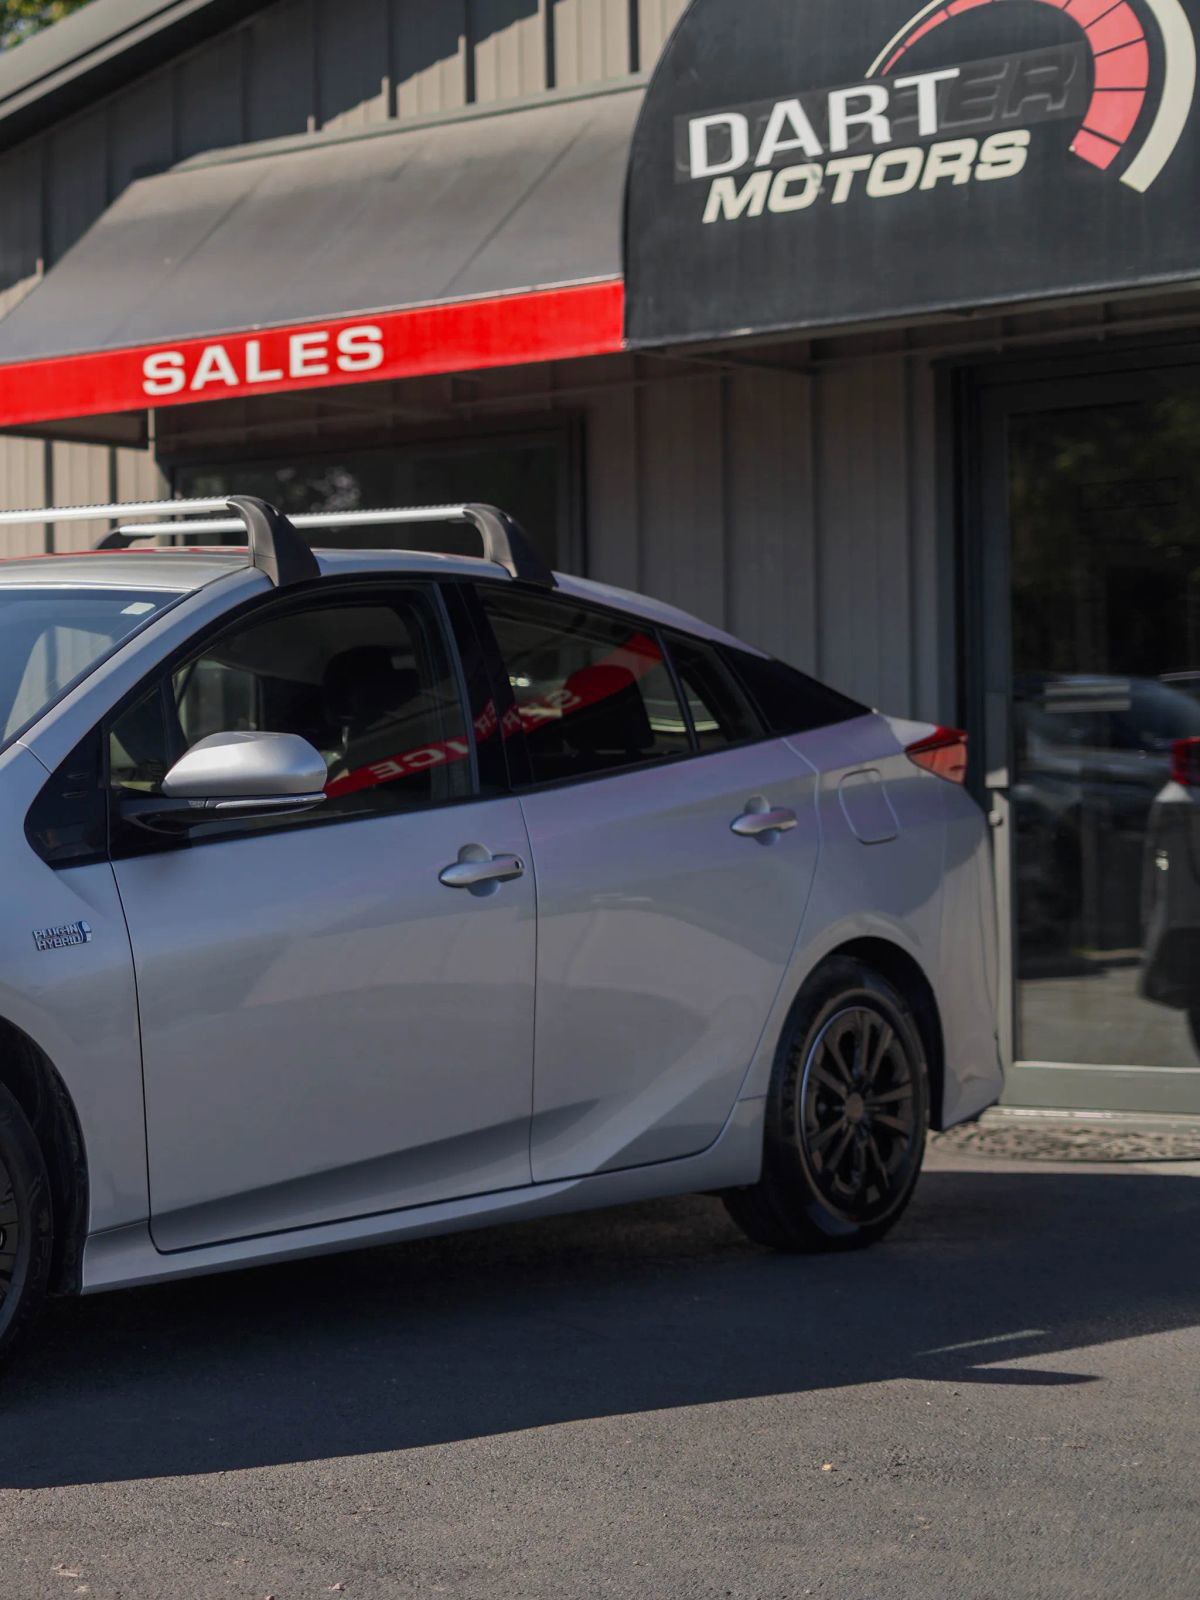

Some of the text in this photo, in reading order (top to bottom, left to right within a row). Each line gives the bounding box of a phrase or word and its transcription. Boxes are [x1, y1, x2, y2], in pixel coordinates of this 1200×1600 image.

[689, 67, 961, 179] DART
[702, 129, 1031, 224] MOTORS
[142, 325, 384, 396] SALES
[36, 935, 83, 951] HYBRID
